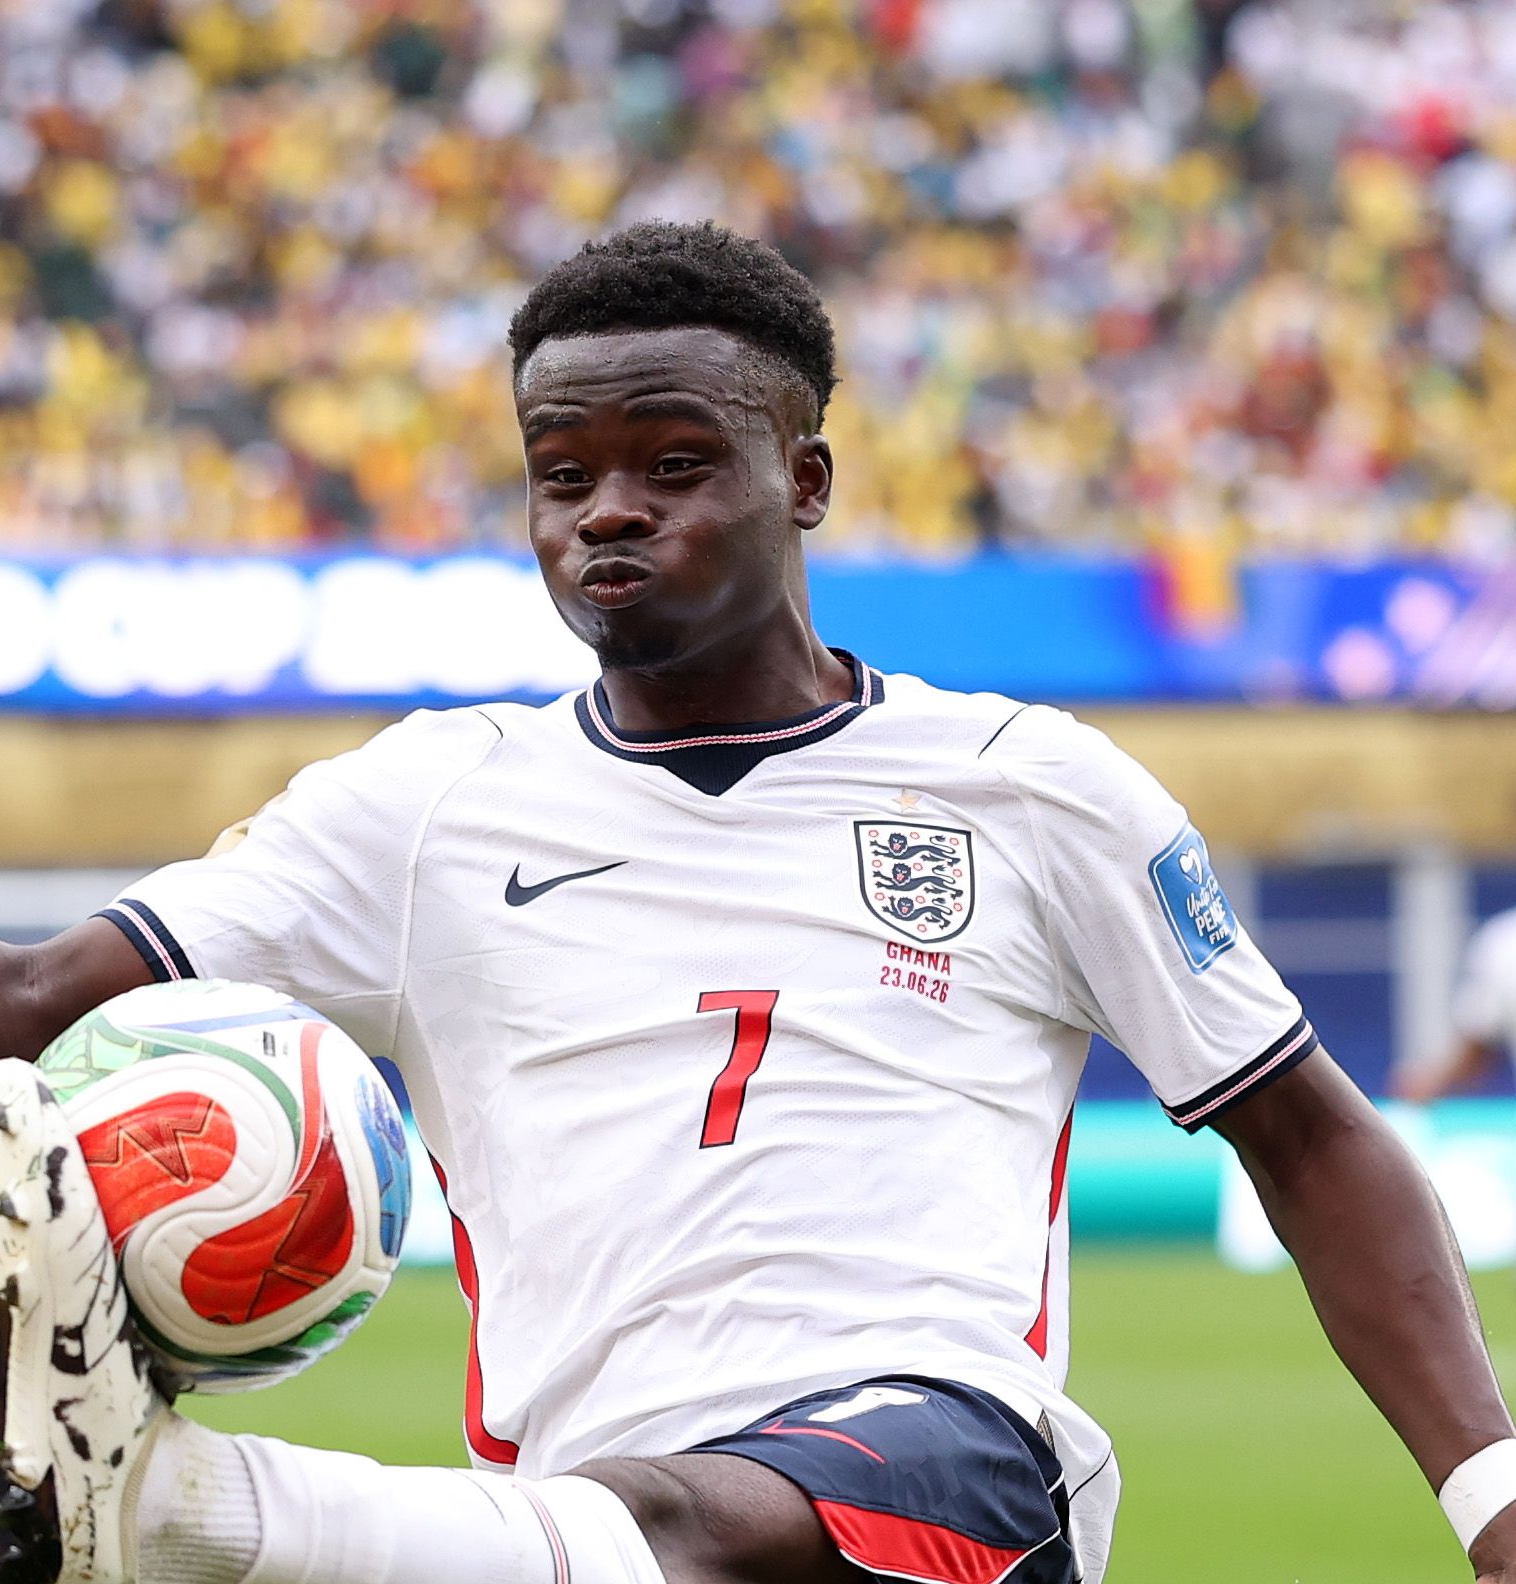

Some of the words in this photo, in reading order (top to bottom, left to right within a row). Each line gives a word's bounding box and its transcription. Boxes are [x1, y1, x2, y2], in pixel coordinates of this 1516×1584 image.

[886, 940, 951, 976] GHANA
[880, 965, 950, 1003] 23.06.26
[697, 990, 780, 1149] 7
